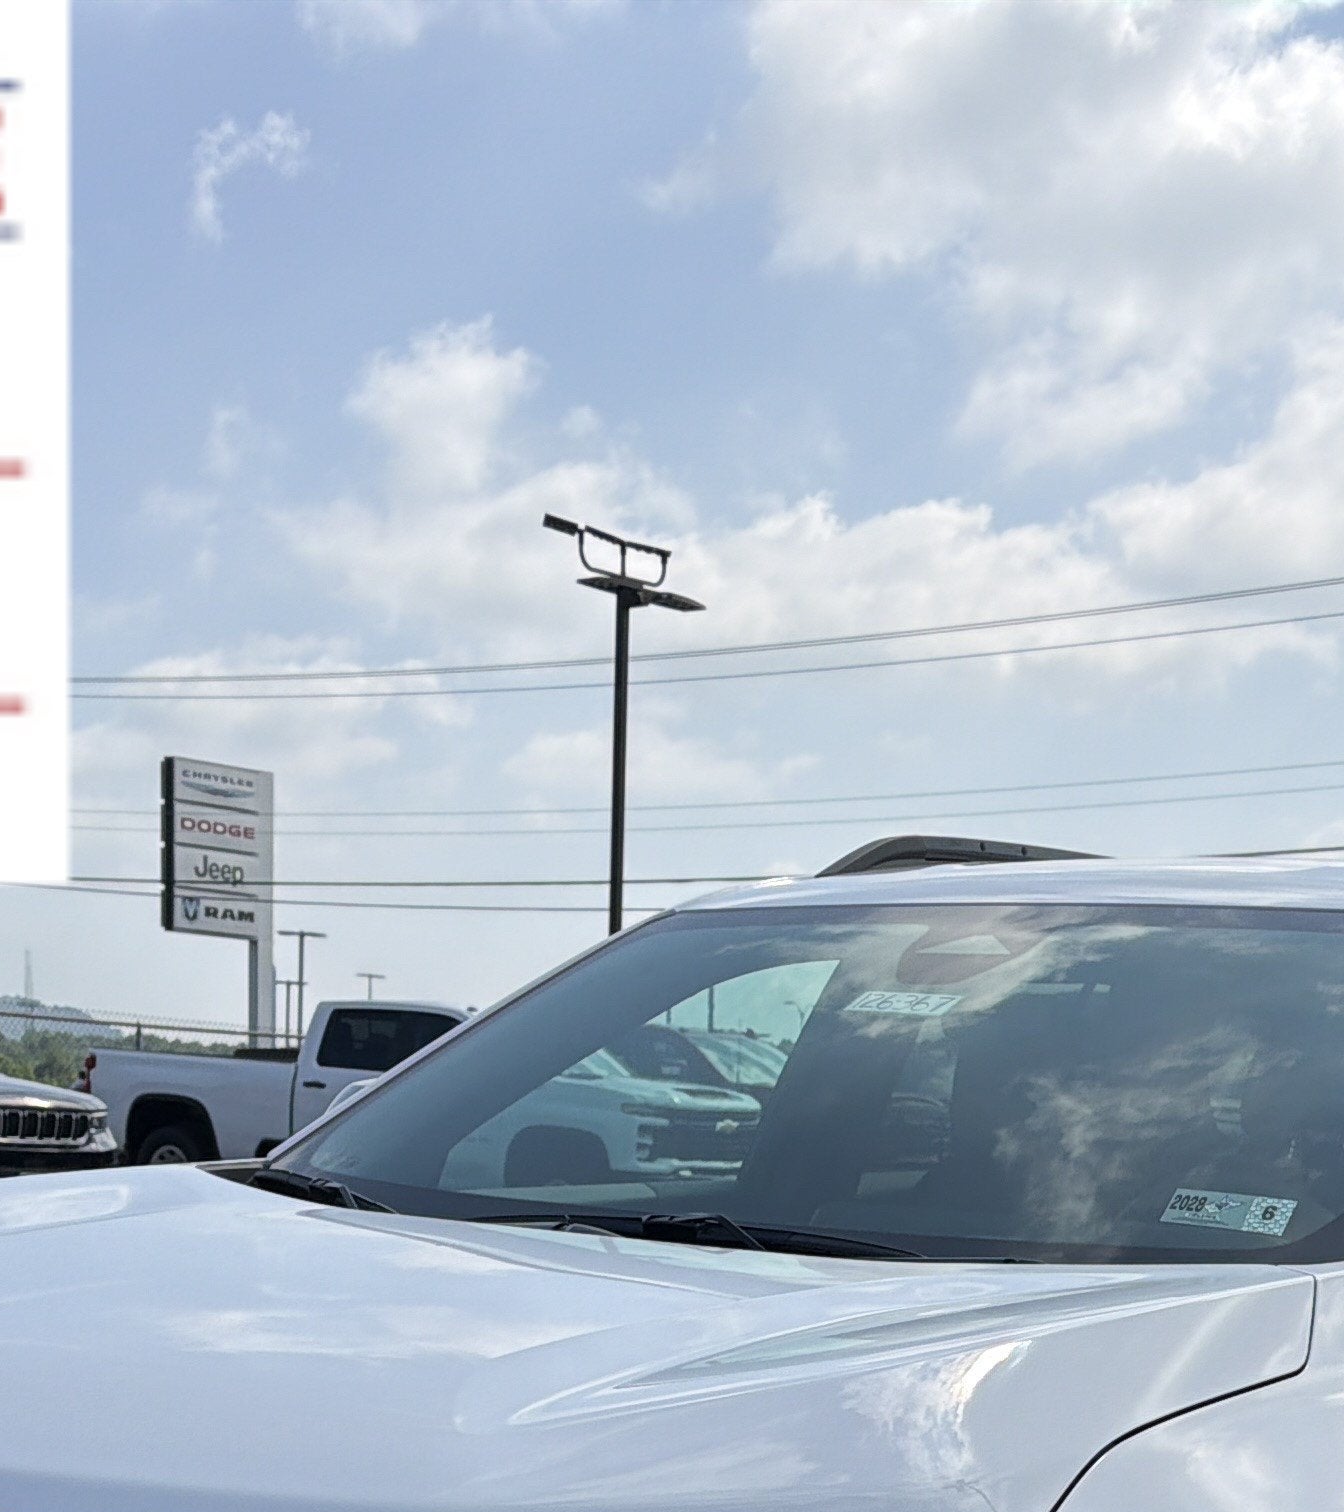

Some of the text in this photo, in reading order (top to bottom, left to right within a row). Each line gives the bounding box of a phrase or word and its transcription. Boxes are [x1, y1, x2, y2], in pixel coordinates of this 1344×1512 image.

[180, 817, 256, 840] DODGE
[194, 855, 245, 887] Jeep
[204, 906, 256, 923] RAM
[1169, 1193, 1278, 1221] 2028 6
